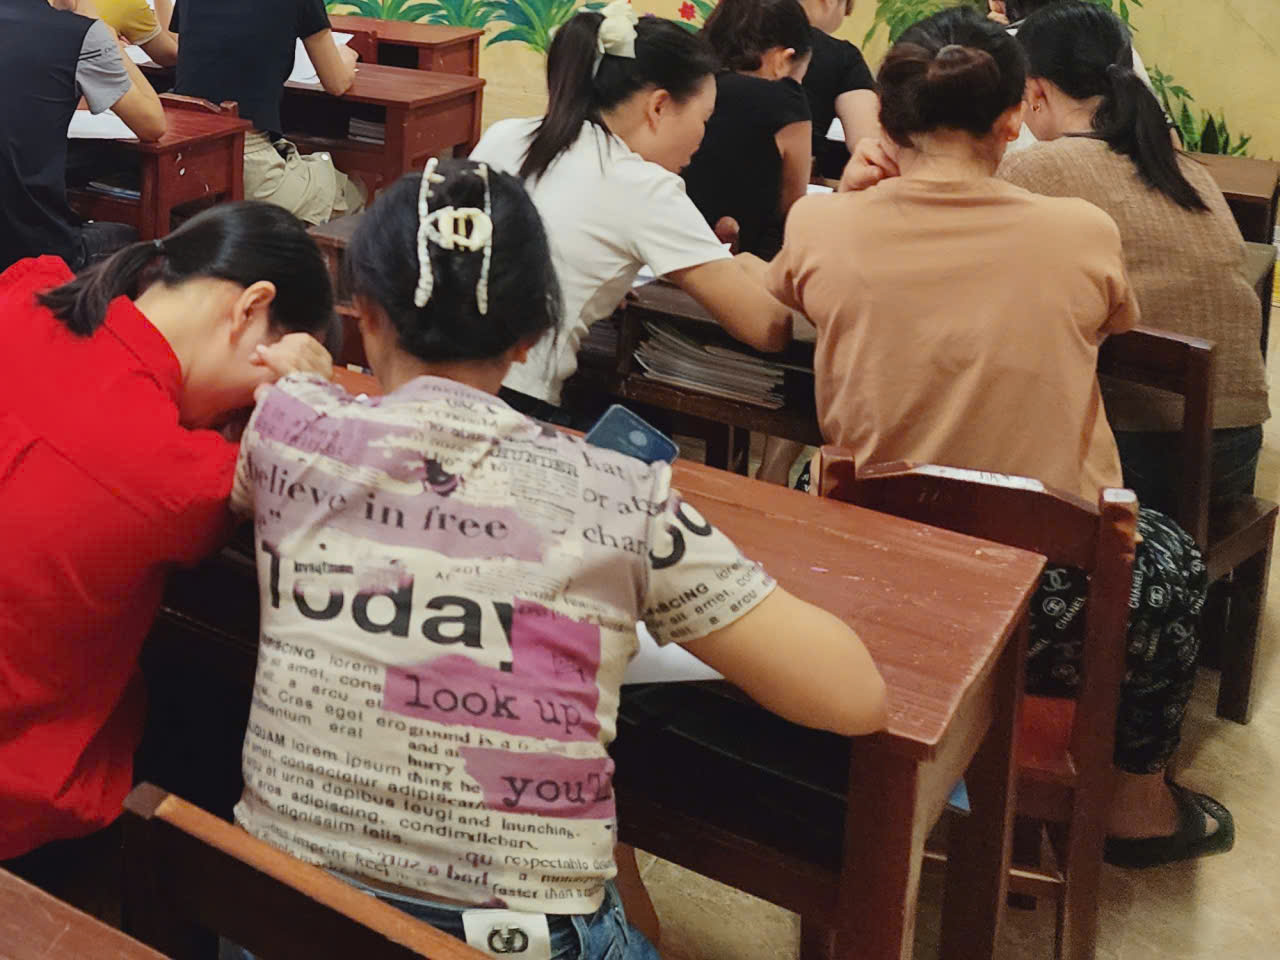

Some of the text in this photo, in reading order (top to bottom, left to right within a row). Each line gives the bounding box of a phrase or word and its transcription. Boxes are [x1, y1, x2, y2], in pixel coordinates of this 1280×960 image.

[365, 492, 405, 530] in
[423, 505, 509, 539] free
[330, 655, 378, 675] lorem
[278, 690, 313, 710] Cras
[312, 685, 349, 702] arcu
[404, 673, 583, 735] look up
[291, 738, 402, 777] lorem ipsum
[408, 740, 439, 756] and
[407, 754, 456, 776] hurry
[282, 771, 315, 790] urna
[407, 771, 453, 792] thing
